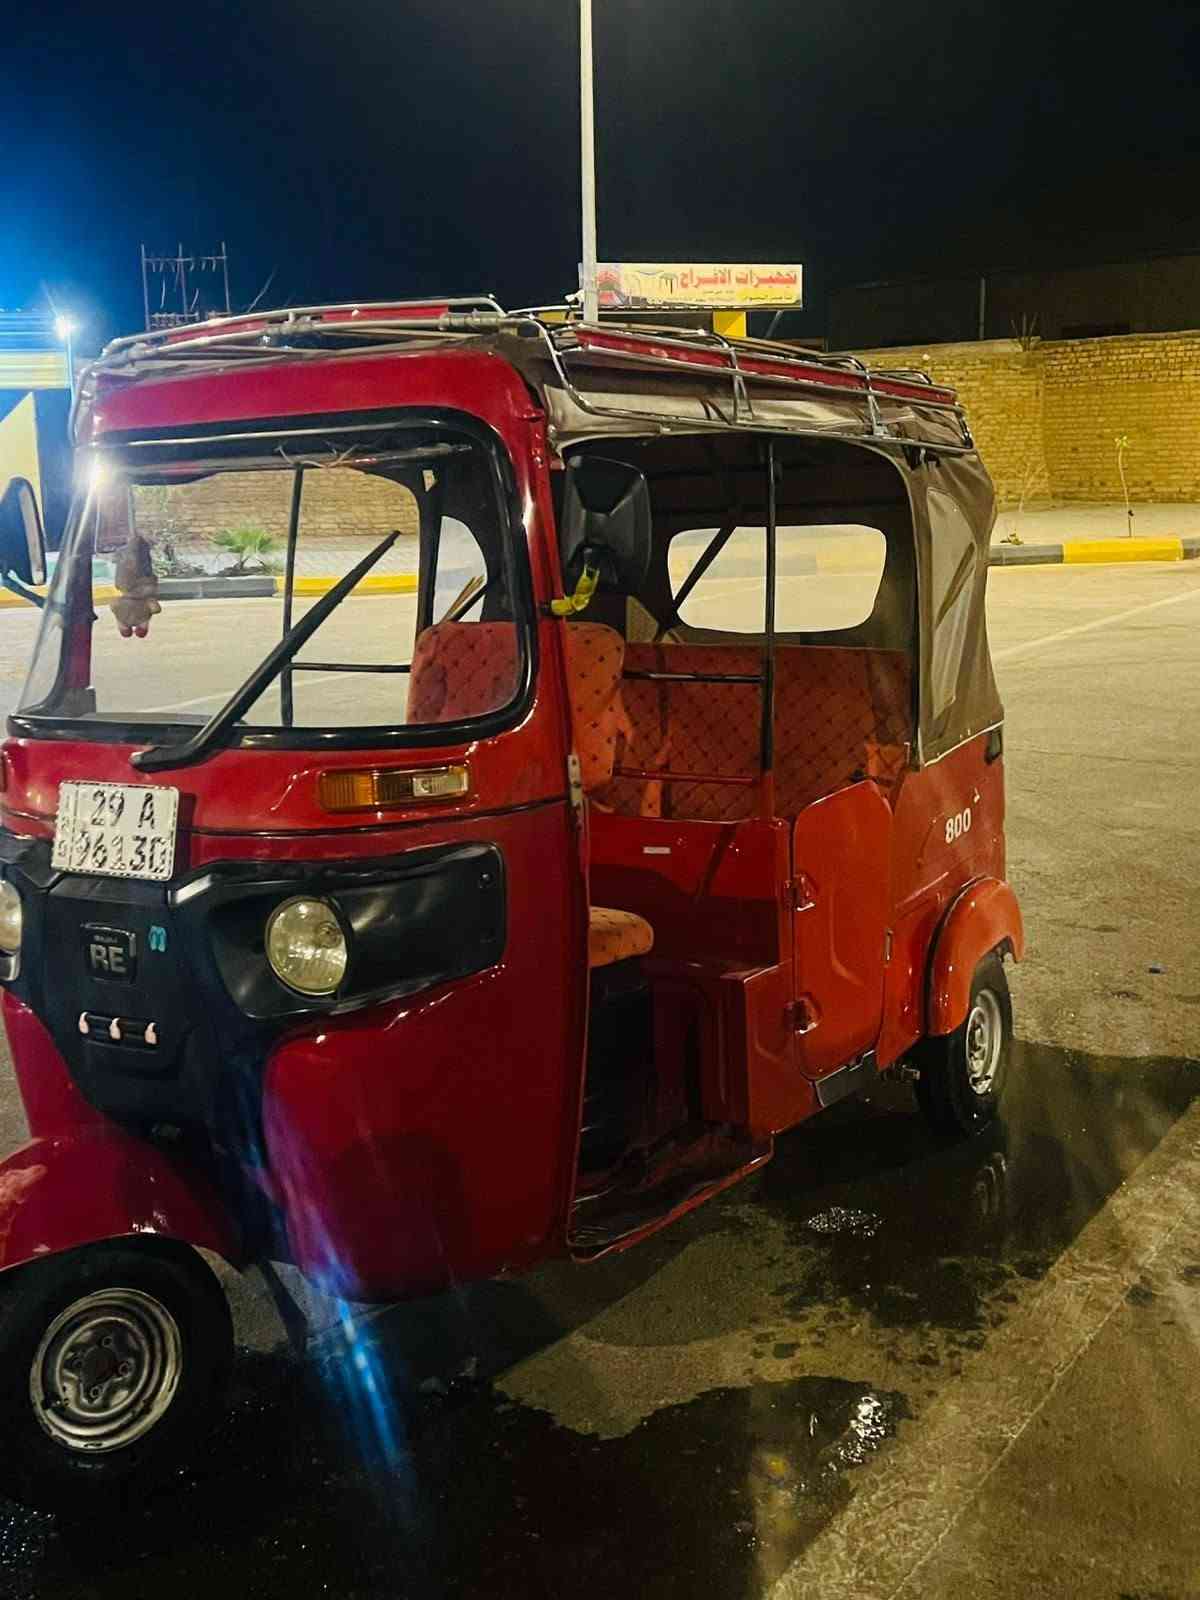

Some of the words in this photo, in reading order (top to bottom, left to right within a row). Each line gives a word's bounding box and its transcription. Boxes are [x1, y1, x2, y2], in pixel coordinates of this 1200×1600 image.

[91, 789, 125, 827] 29
[137, 792, 156, 830] A
[945, 807, 972, 844] 800
[90, 943, 127, 973] RE
